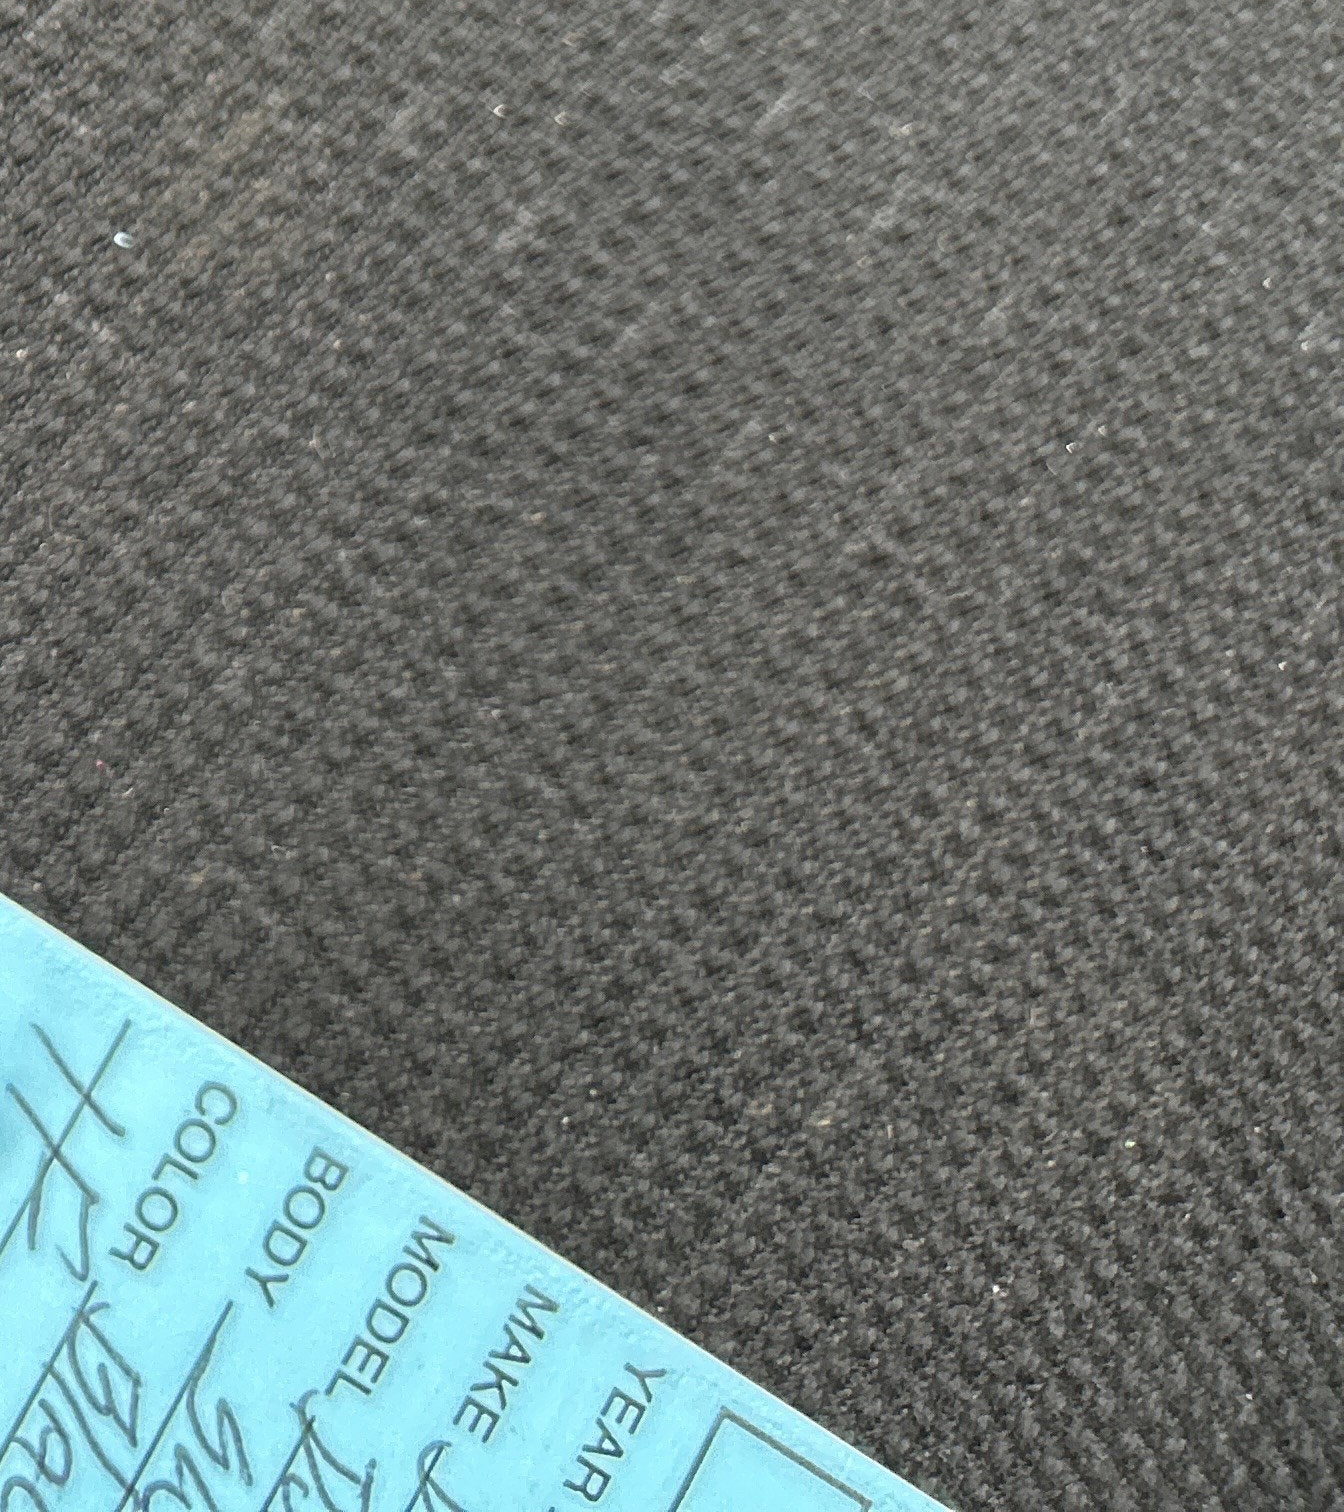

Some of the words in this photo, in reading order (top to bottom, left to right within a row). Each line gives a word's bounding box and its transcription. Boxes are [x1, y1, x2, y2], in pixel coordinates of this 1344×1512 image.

[108, 1080, 239, 1272] COLOR
[245, 1145, 350, 1308] BODY
[324, 1214, 456, 1396] MODEL
[453, 1283, 560, 1443] MAKE
[562, 1361, 668, 1503] YEAR
